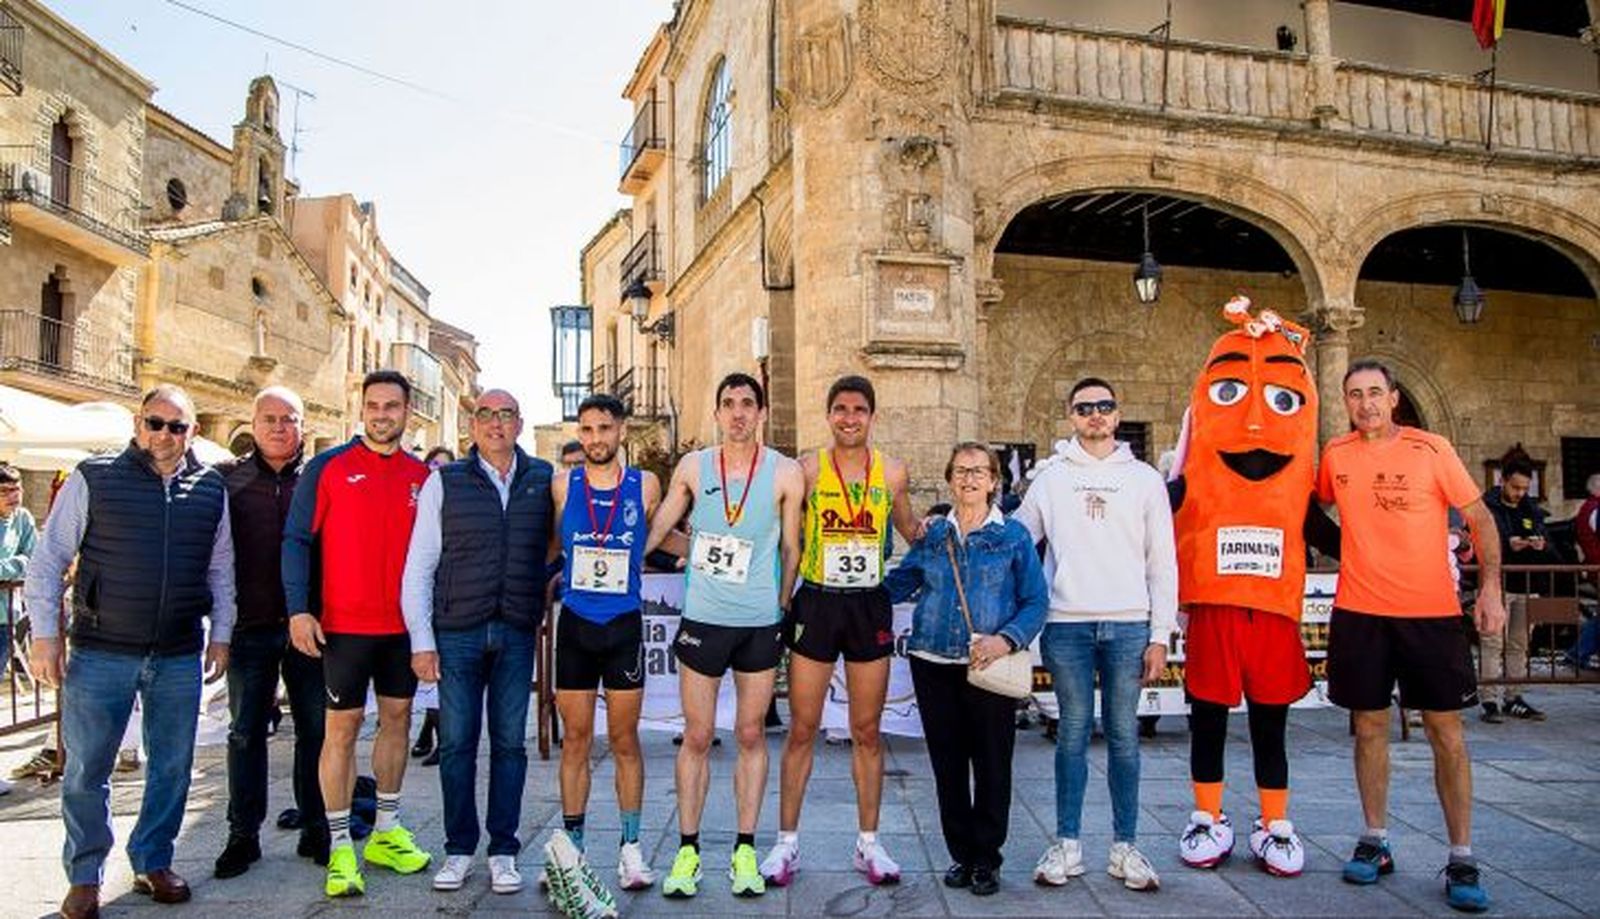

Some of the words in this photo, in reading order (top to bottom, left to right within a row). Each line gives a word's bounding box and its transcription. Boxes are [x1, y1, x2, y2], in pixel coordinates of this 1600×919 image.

[707, 546, 735, 567] 51
[839, 555, 866, 573] 33
[594, 559, 608, 577] 9
